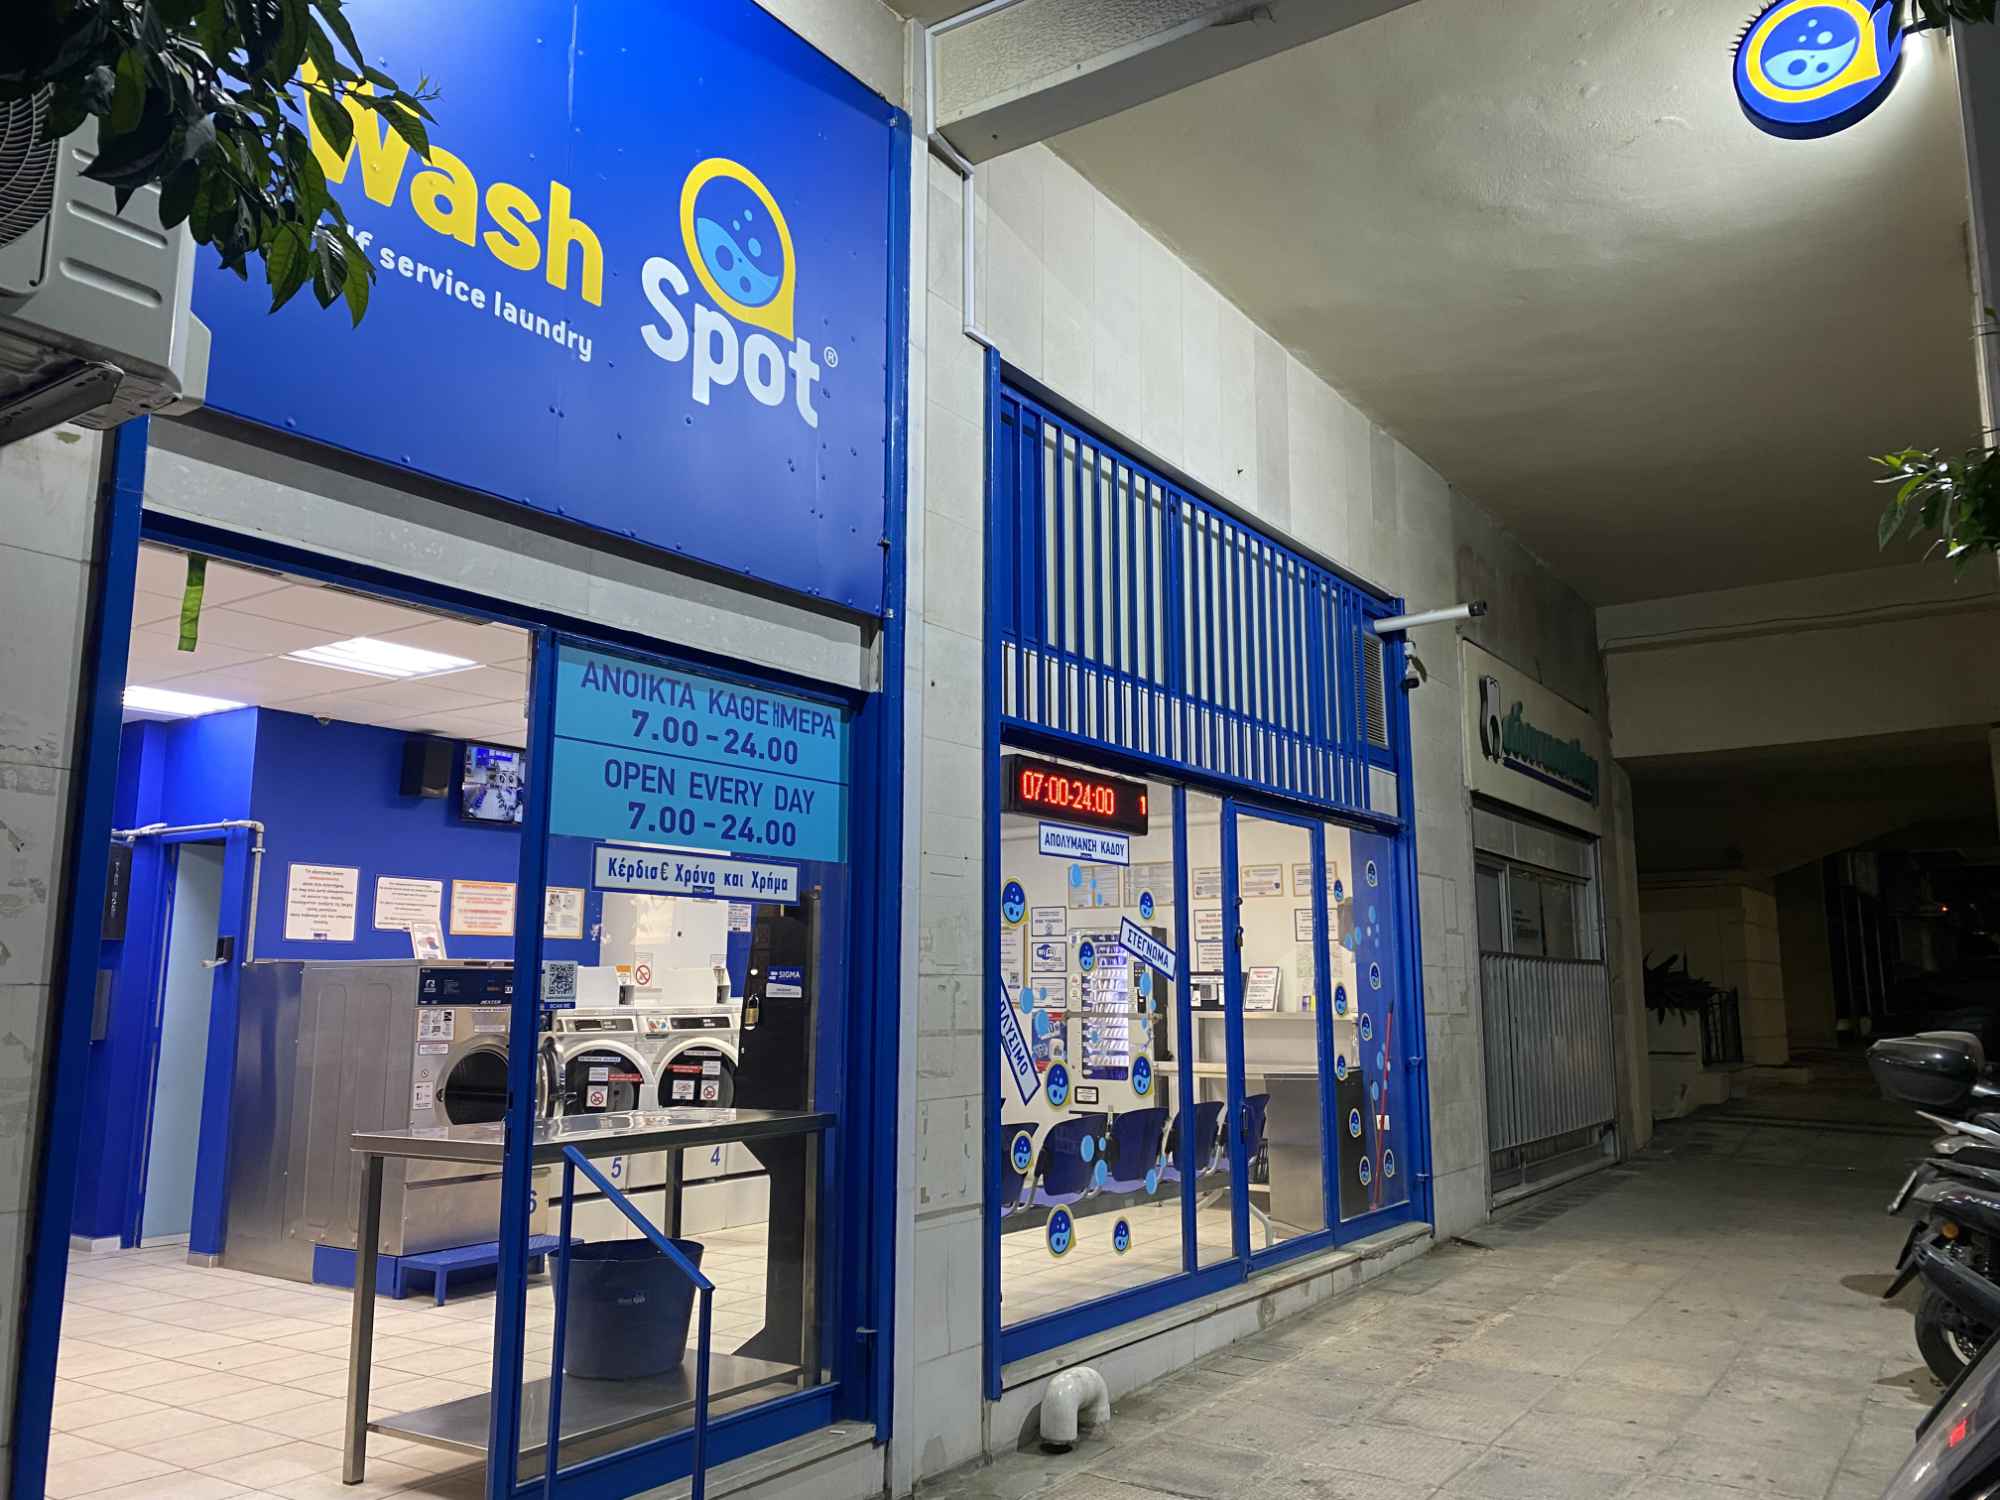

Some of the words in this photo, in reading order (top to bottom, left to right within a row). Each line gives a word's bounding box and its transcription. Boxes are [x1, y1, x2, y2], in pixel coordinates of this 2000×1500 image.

[300, 46, 603, 306] Wash
[379, 247, 486, 309] service
[494, 290, 592, 363] laundry
[580, 660, 696, 711] ΑΝΟΙΚΤΑ
[604, 758, 676, 796] OPEN
[689, 770, 764, 808] EVERY
[774, 785, 815, 815] DAY
[1022, 770, 1114, 815] 07:00-24:00
[1044, 831, 1097, 853] ΑΠΟΛΥΜΑΝΣΗ
[1100, 842, 1125, 857] ΚΑΔΟΥ
[674, 864, 716, 885] Χρόνο
[723, 871, 744, 887] και
[751, 870, 789, 894] Χρήμα
[1127, 928, 1169, 969] ΣΤΕΓΝΩΜΑ
[611, 1156, 622, 1178] 5
[710, 1145, 721, 1166] 4
